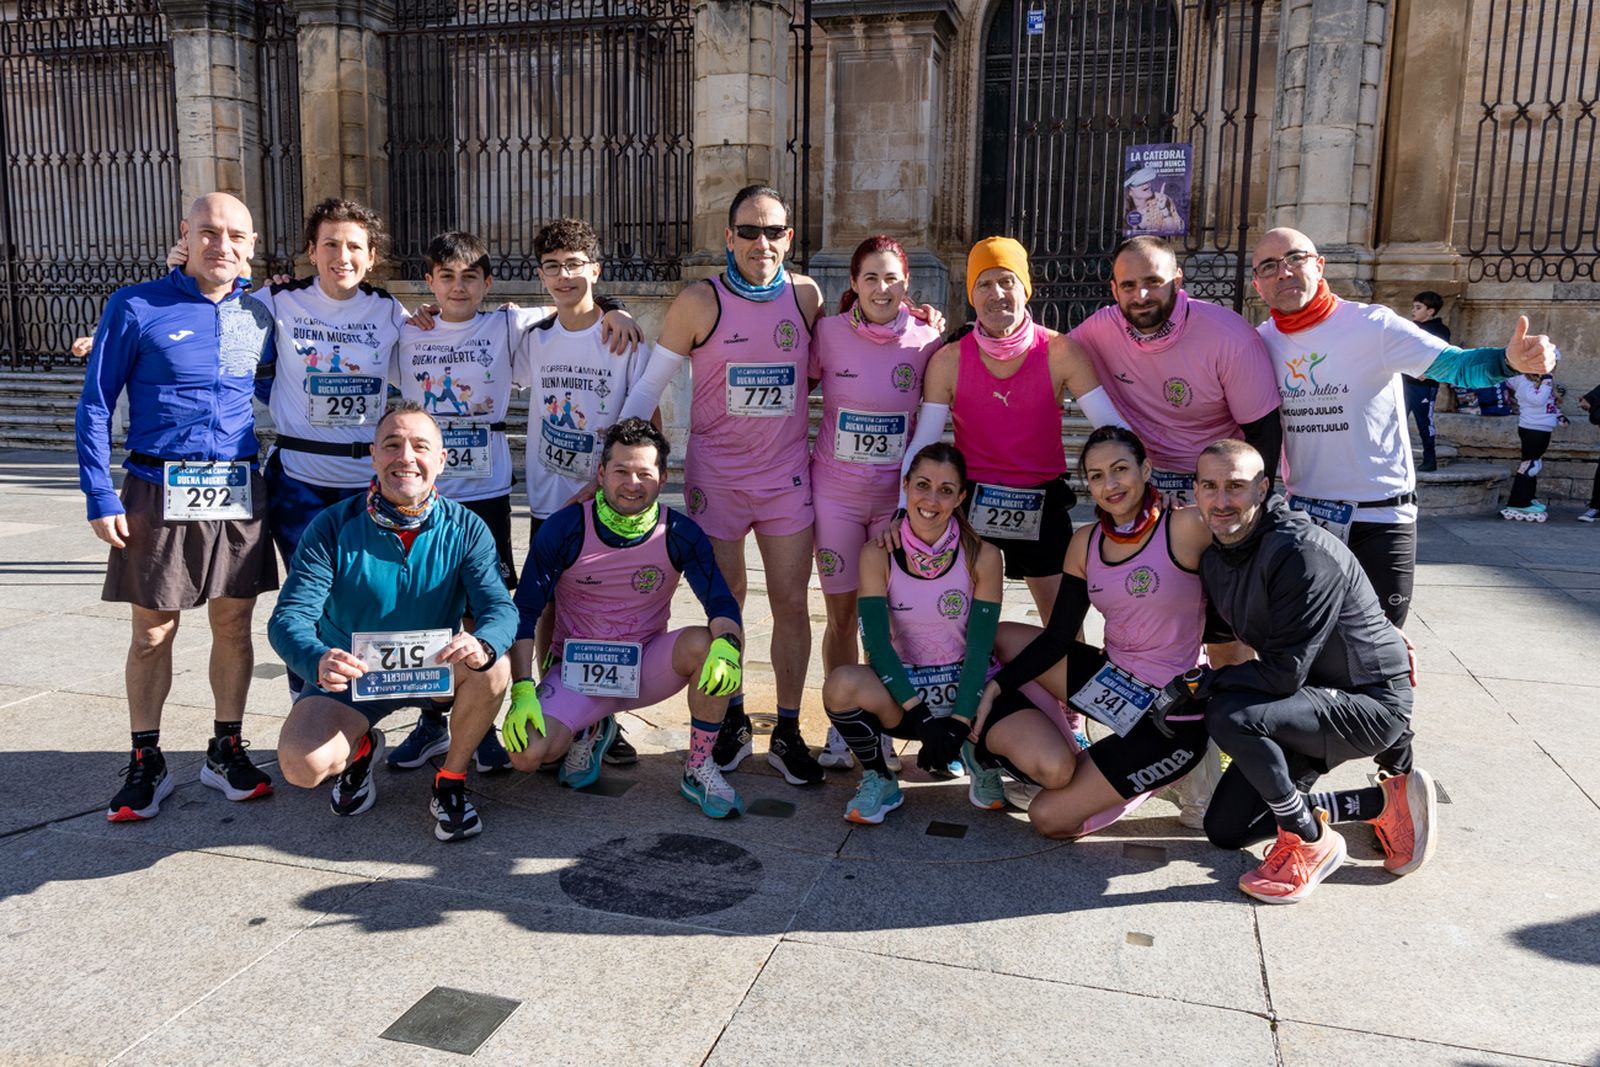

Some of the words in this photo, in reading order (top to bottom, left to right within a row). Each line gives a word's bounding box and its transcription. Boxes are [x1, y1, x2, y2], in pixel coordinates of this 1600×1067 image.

[1131, 152, 1141, 161] LA
[1143, 150, 1186, 160] CATEDRAL
[293, 327, 326, 342] BUENA
[327, 331, 361, 344] MUERTE
[422, 344, 455, 353] CARRERA
[438, 351, 475, 364] MUERTE
[574, 366, 612, 377] CAMINATA
[562, 377, 593, 391] MUERTE
[737, 377, 756, 385] BUENA
[757, 376, 779, 384] MUERTE
[318, 386, 339, 394] BUENA
[340, 386, 362, 394] MUERTE
[745, 387, 783, 406] 772
[327, 396, 366, 415] 293
[846, 422, 865, 431] BUENA
[866, 424, 888, 433] MUERTE
[445, 437, 468, 446] MUERTE
[554, 437, 574, 449] MUERTE
[854, 434, 888, 453] 193
[446, 449, 474, 467] 34
[545, 444, 578, 467] 447
[177, 476, 200, 485] BUENA
[201, 476, 227, 485] MUERTE
[1159, 479, 1183, 488] MUERTE
[187, 487, 232, 507] 292
[1001, 499, 1024, 508] MUERTE
[986, 508, 1025, 527] 229
[380, 645, 425, 671] 512
[573, 652, 594, 661] BUENA
[595, 653, 619, 663] MUERTE
[382, 671, 414, 683] MUERTE
[415, 670, 440, 681] BUENA
[583, 664, 618, 684] 194
[929, 673, 952, 683] MUERTE
[367, 685, 401, 693] CAMINATA
[917, 684, 957, 705] 230
[1094, 689, 1128, 716] 341
